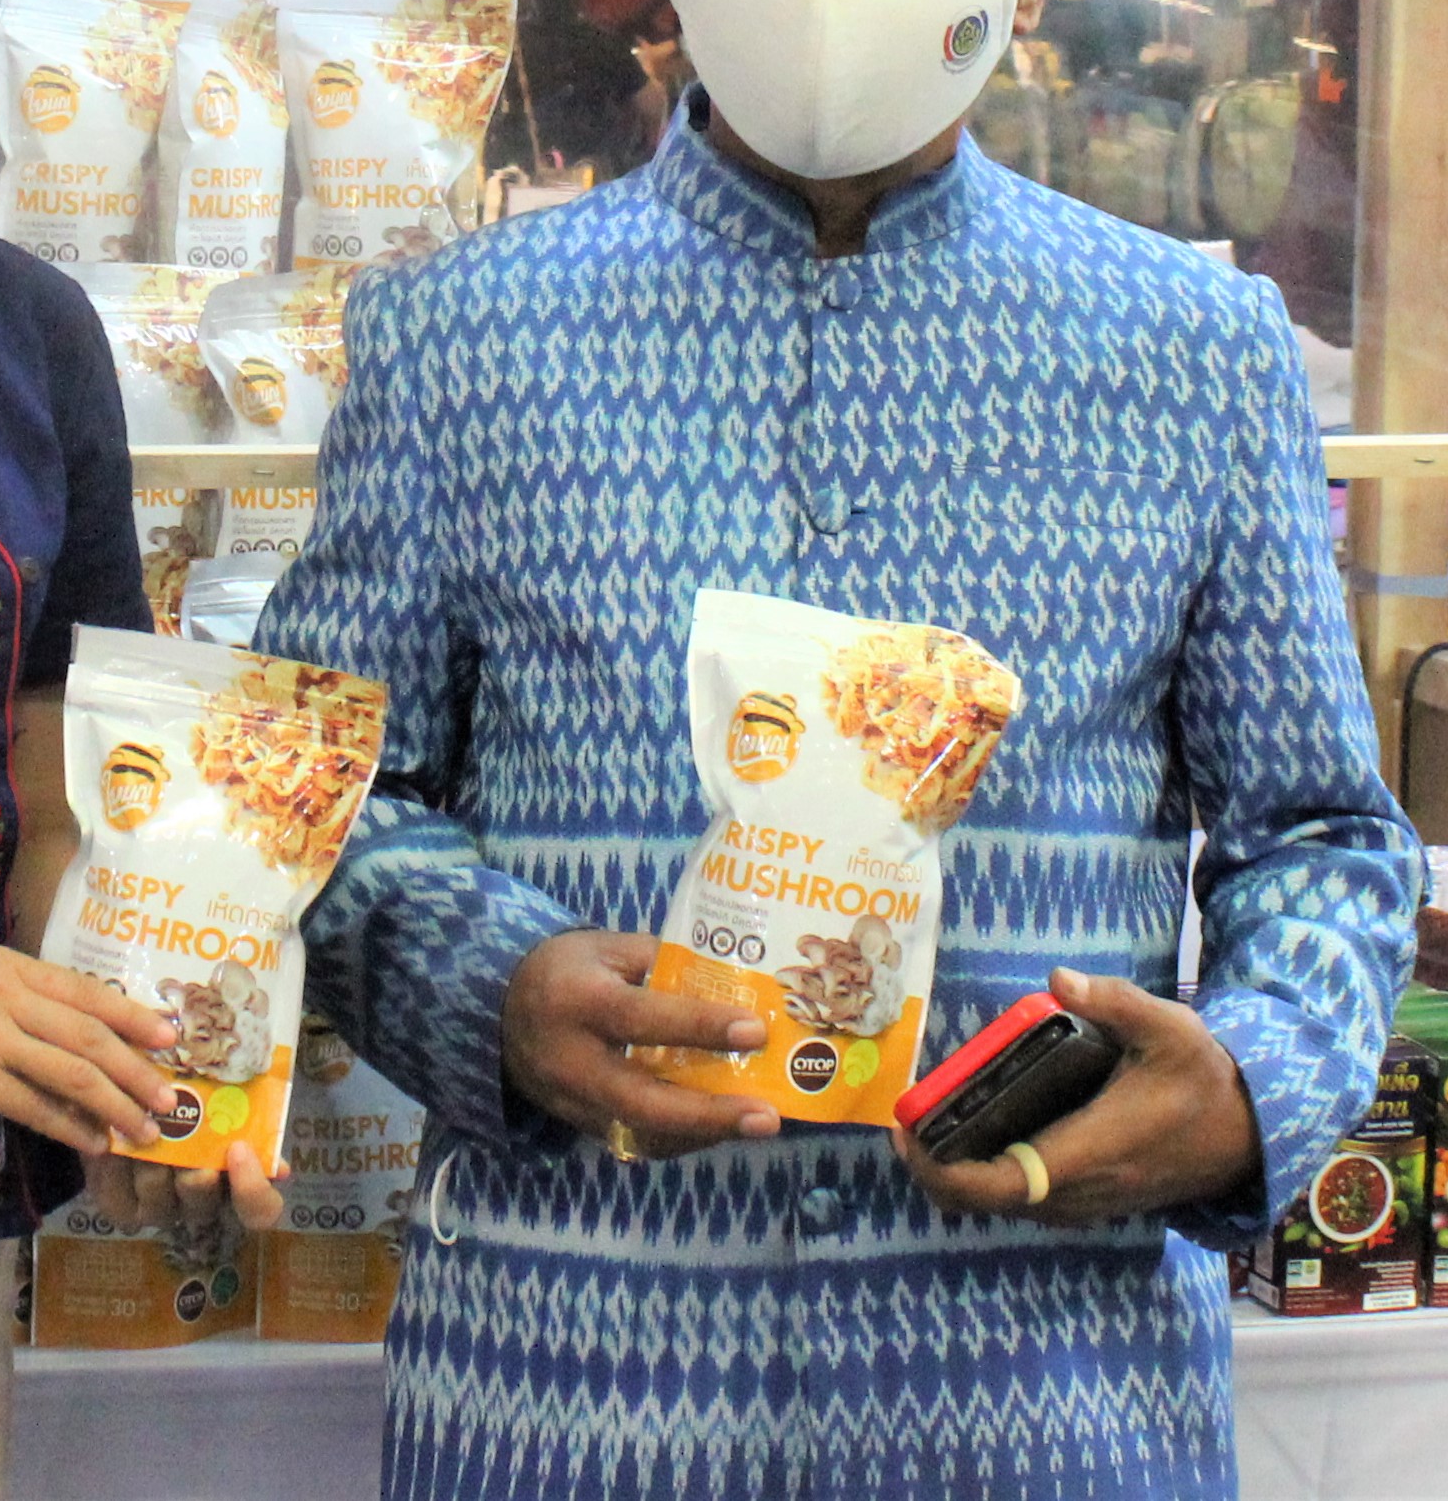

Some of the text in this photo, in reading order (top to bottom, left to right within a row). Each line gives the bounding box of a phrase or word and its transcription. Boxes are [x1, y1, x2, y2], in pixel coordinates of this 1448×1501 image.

[19, 163, 110, 186] CRISPY
[190, 168, 263, 188] CRISPY
[719, 819, 825, 866] RISPY
[84, 865, 186, 910] CRISPY
[700, 849, 922, 925] MUSHROOM
[76, 896, 284, 973] MUSHROOM
[793, 1057, 835, 1071] OTOP
[291, 1113, 390, 1140] CRISPY
